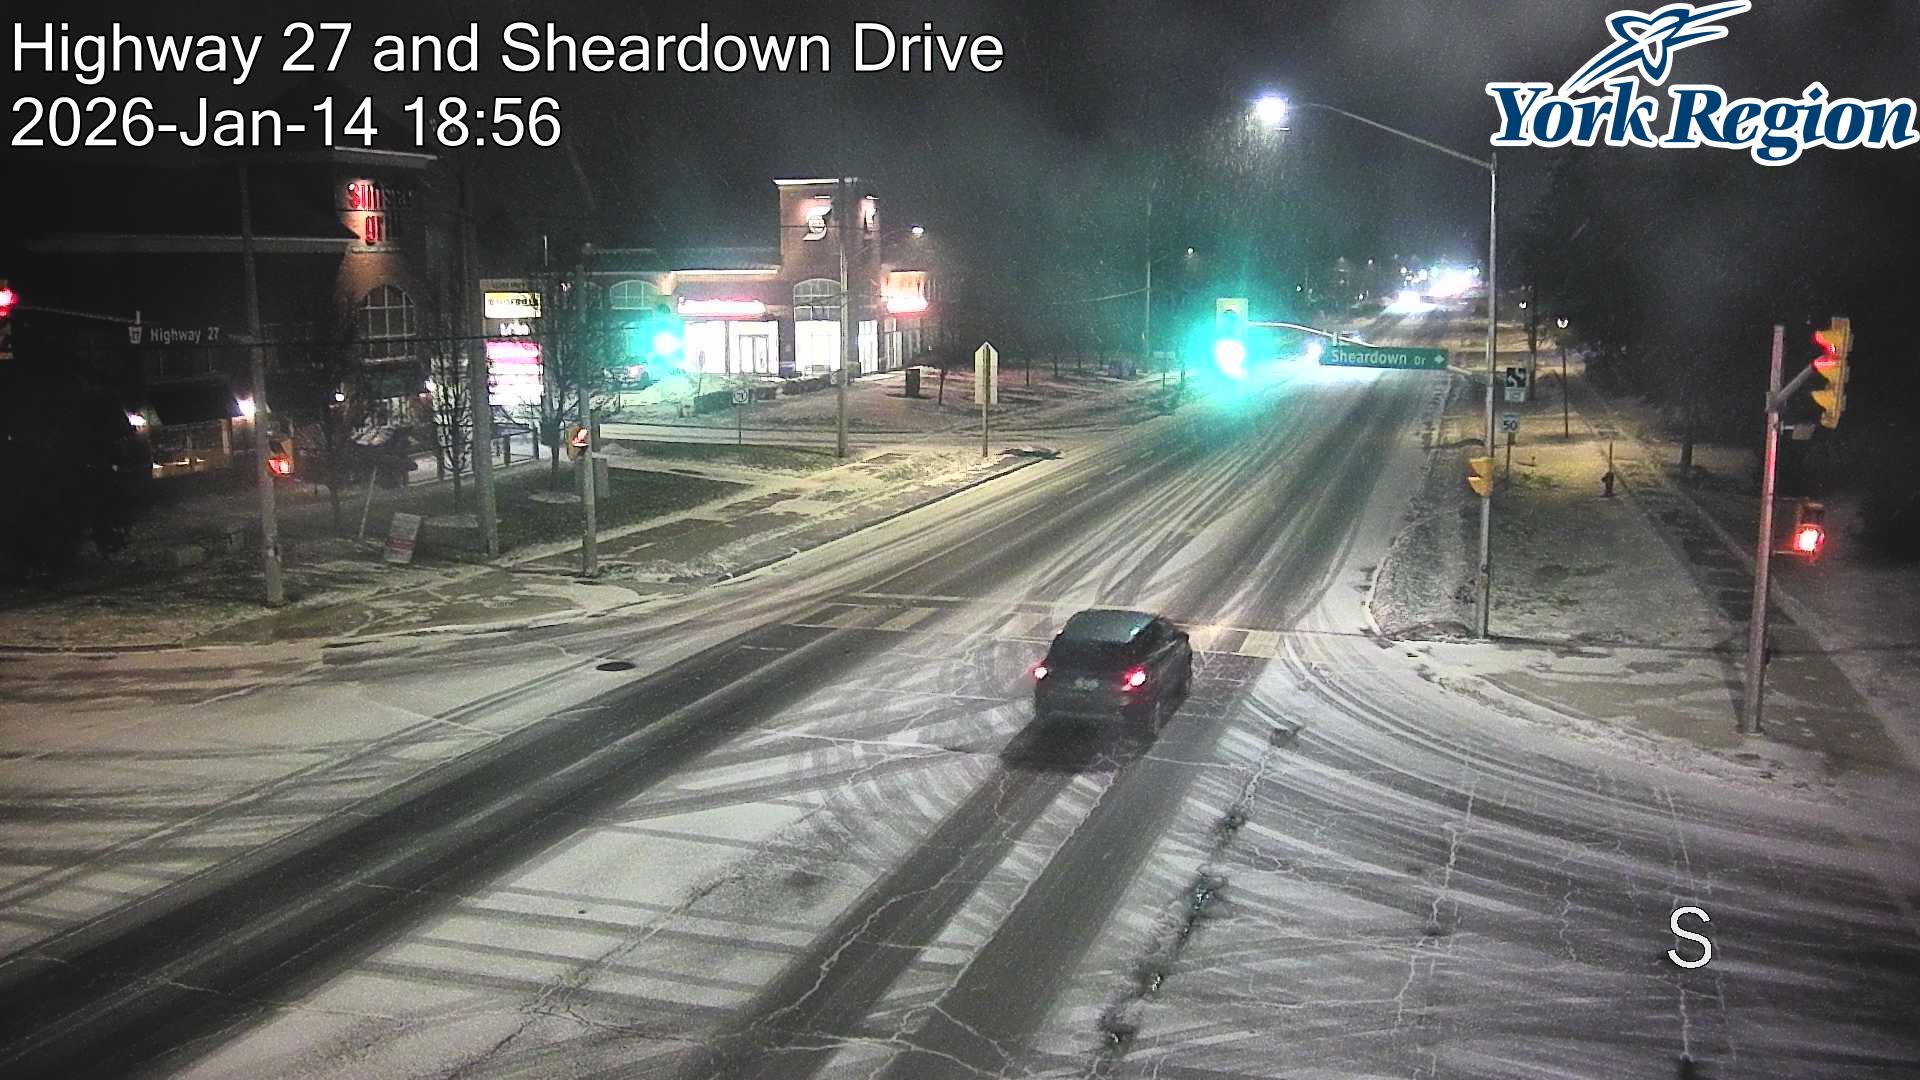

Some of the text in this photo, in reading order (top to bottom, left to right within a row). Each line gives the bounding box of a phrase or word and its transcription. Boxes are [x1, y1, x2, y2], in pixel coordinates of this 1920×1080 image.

[150, 327, 220, 344] Highway 27
[1331, 349, 1425, 365] Sheardown Dr
[1503, 420, 1518, 431] 50
